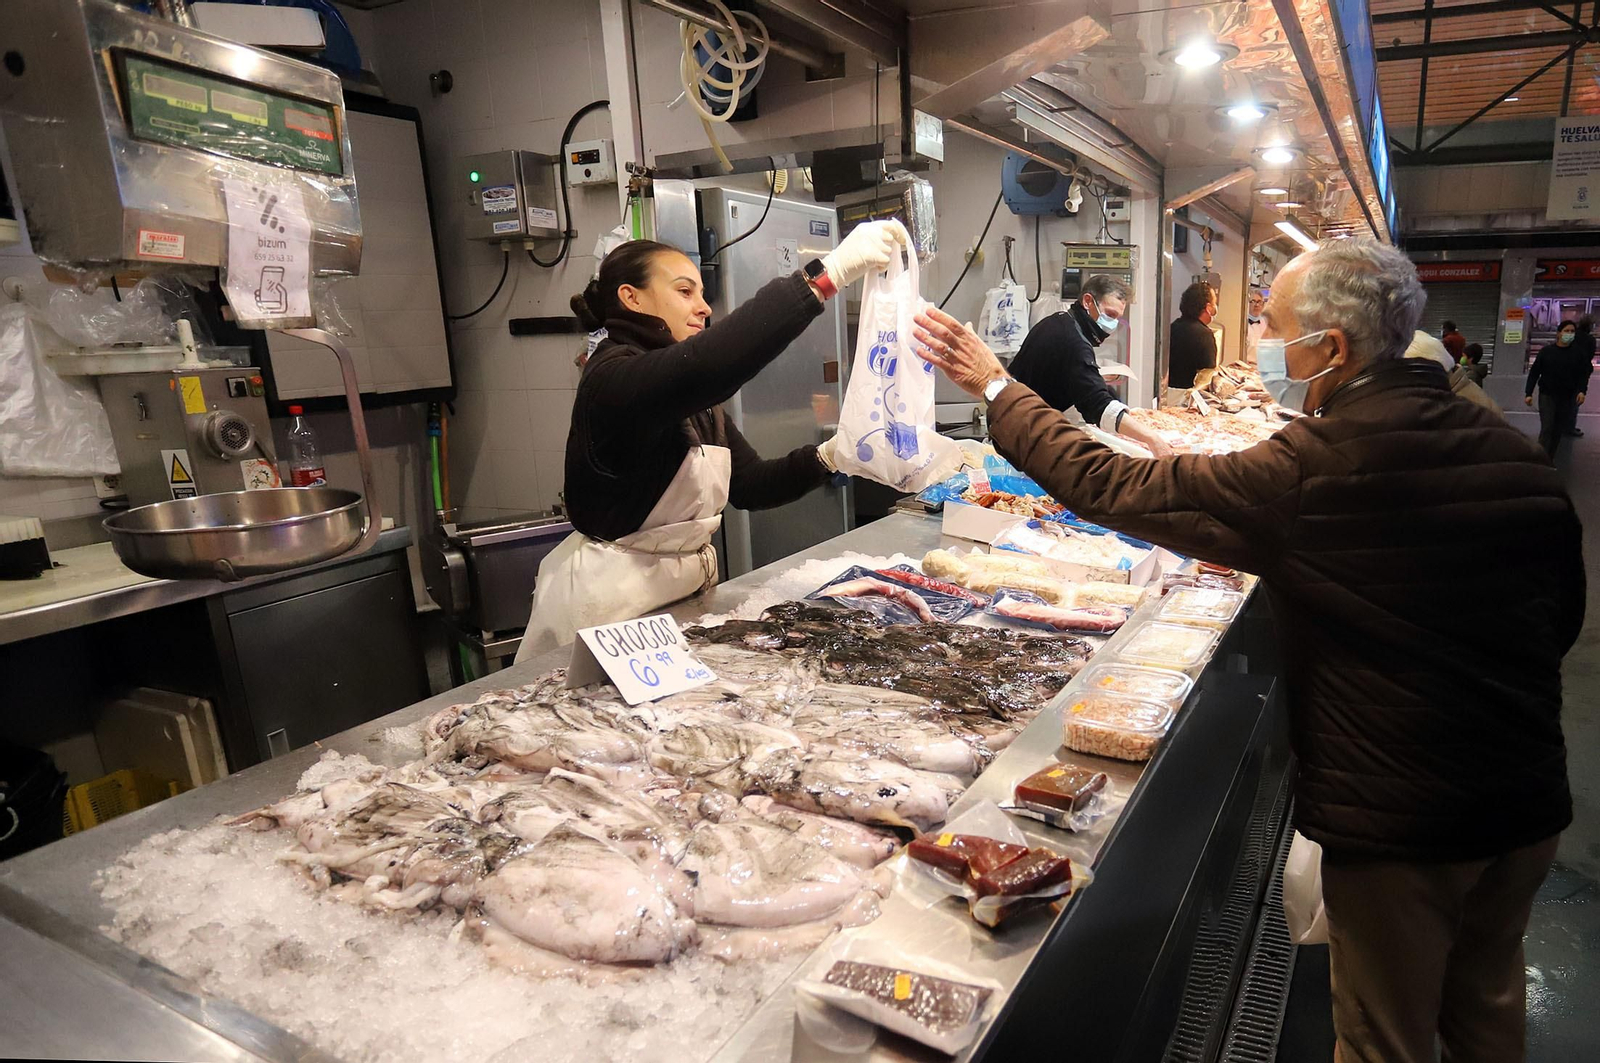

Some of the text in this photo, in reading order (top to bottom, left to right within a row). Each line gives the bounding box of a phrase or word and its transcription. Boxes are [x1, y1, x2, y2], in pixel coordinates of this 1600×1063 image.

[304, 129, 320, 138] TOTAL
[1561, 126, 1600, 135] HUELVA
[1561, 135, 1573, 143] TE
[299, 149, 331, 162] MINERVA
[258, 236, 287, 249] bizum
[594, 617, 677, 657] CHOCOS
